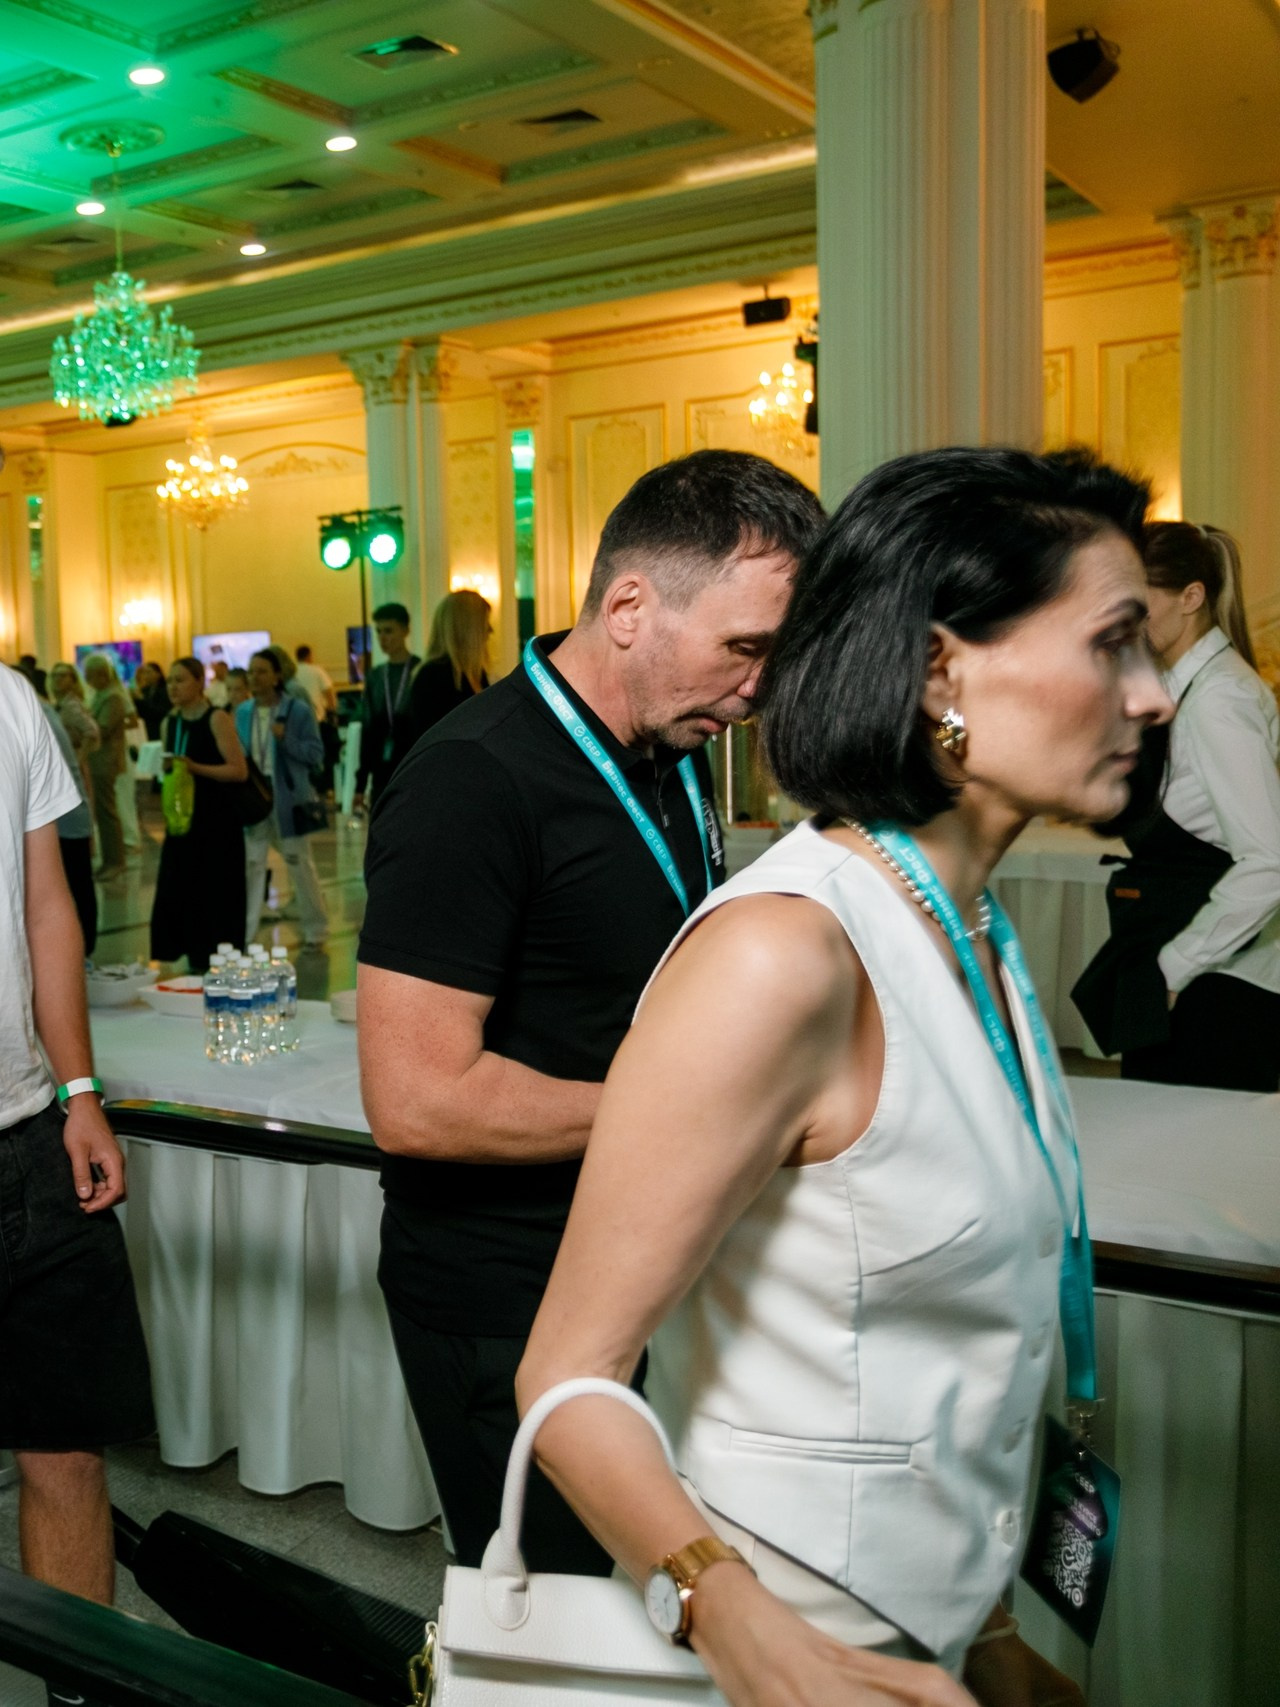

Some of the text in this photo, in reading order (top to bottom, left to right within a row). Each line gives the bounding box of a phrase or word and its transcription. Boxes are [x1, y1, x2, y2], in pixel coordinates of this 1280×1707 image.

[530, 662, 574, 721] Бизнес Фест
[582, 736, 601, 758] СБЕР
[602, 760, 645, 823] Бизнес Фест
[652, 839, 667, 860] СБЕР
[898, 846, 963, 941] Бизнес Фест
[985, 1013, 1007, 1052] Фест
